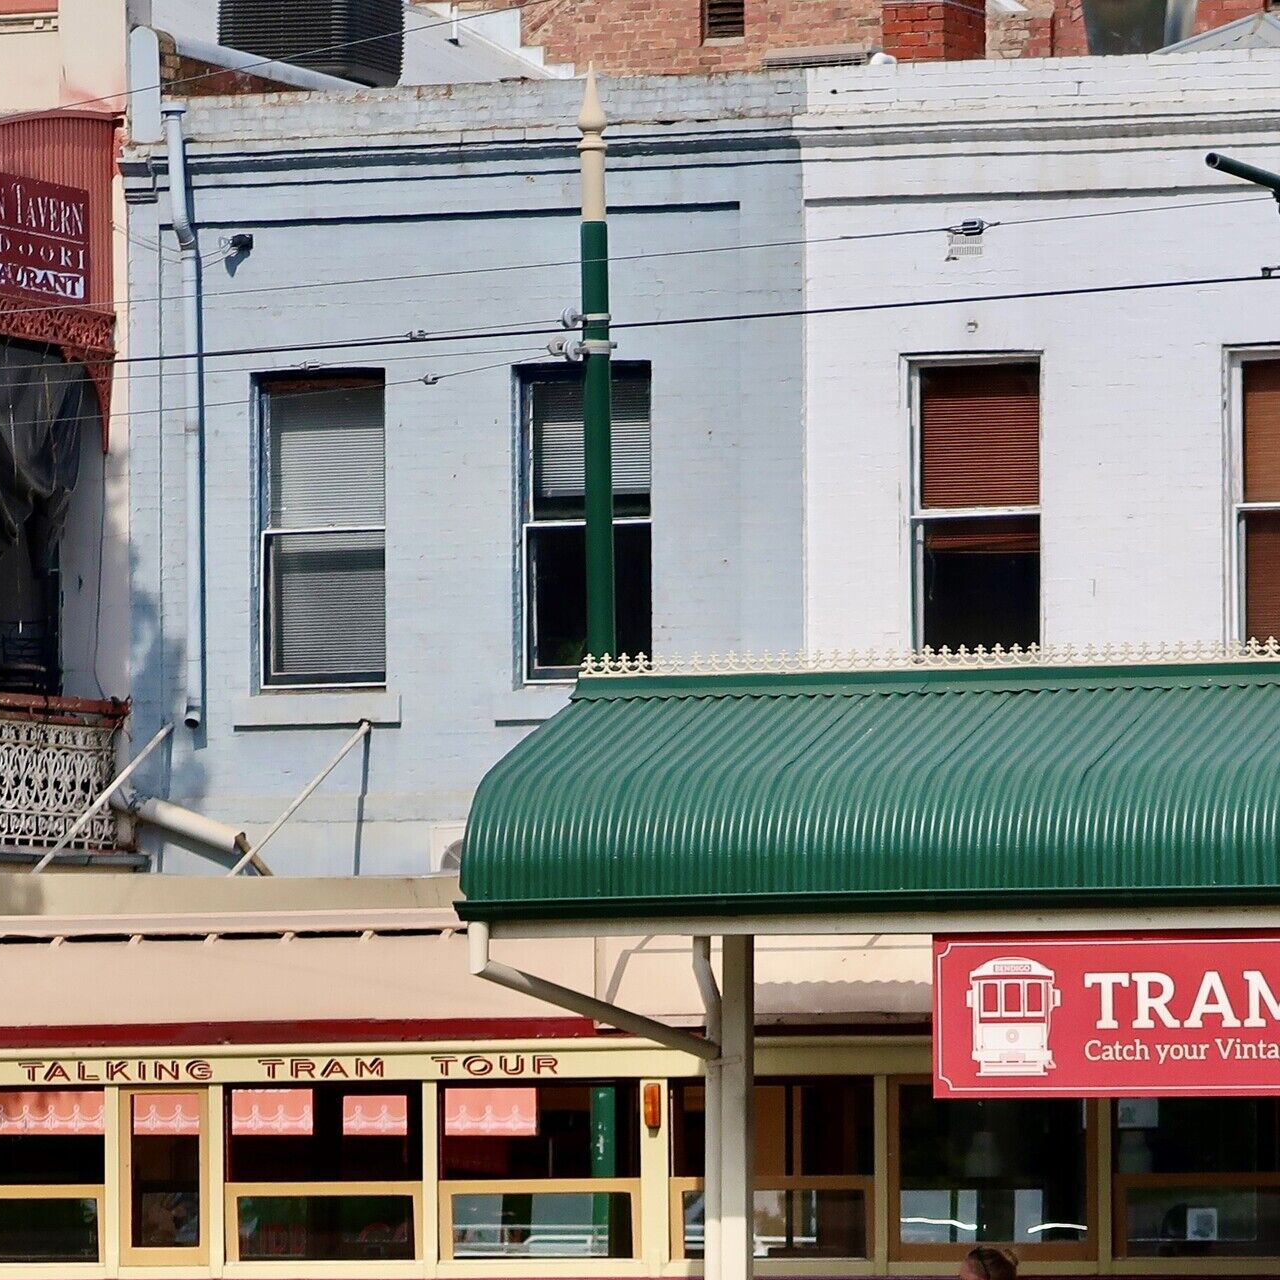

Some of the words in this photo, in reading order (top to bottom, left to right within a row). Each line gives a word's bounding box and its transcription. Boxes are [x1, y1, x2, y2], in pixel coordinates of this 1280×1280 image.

[11, 183, 85, 236] TAVERN
[1084, 1039, 1150, 1061] Catch
[1156, 1043, 1210, 1064] your
[18, 1059, 214, 1085] TALKING
[258, 1056, 385, 1080] TRAM
[430, 1054, 560, 1077] TOUR
